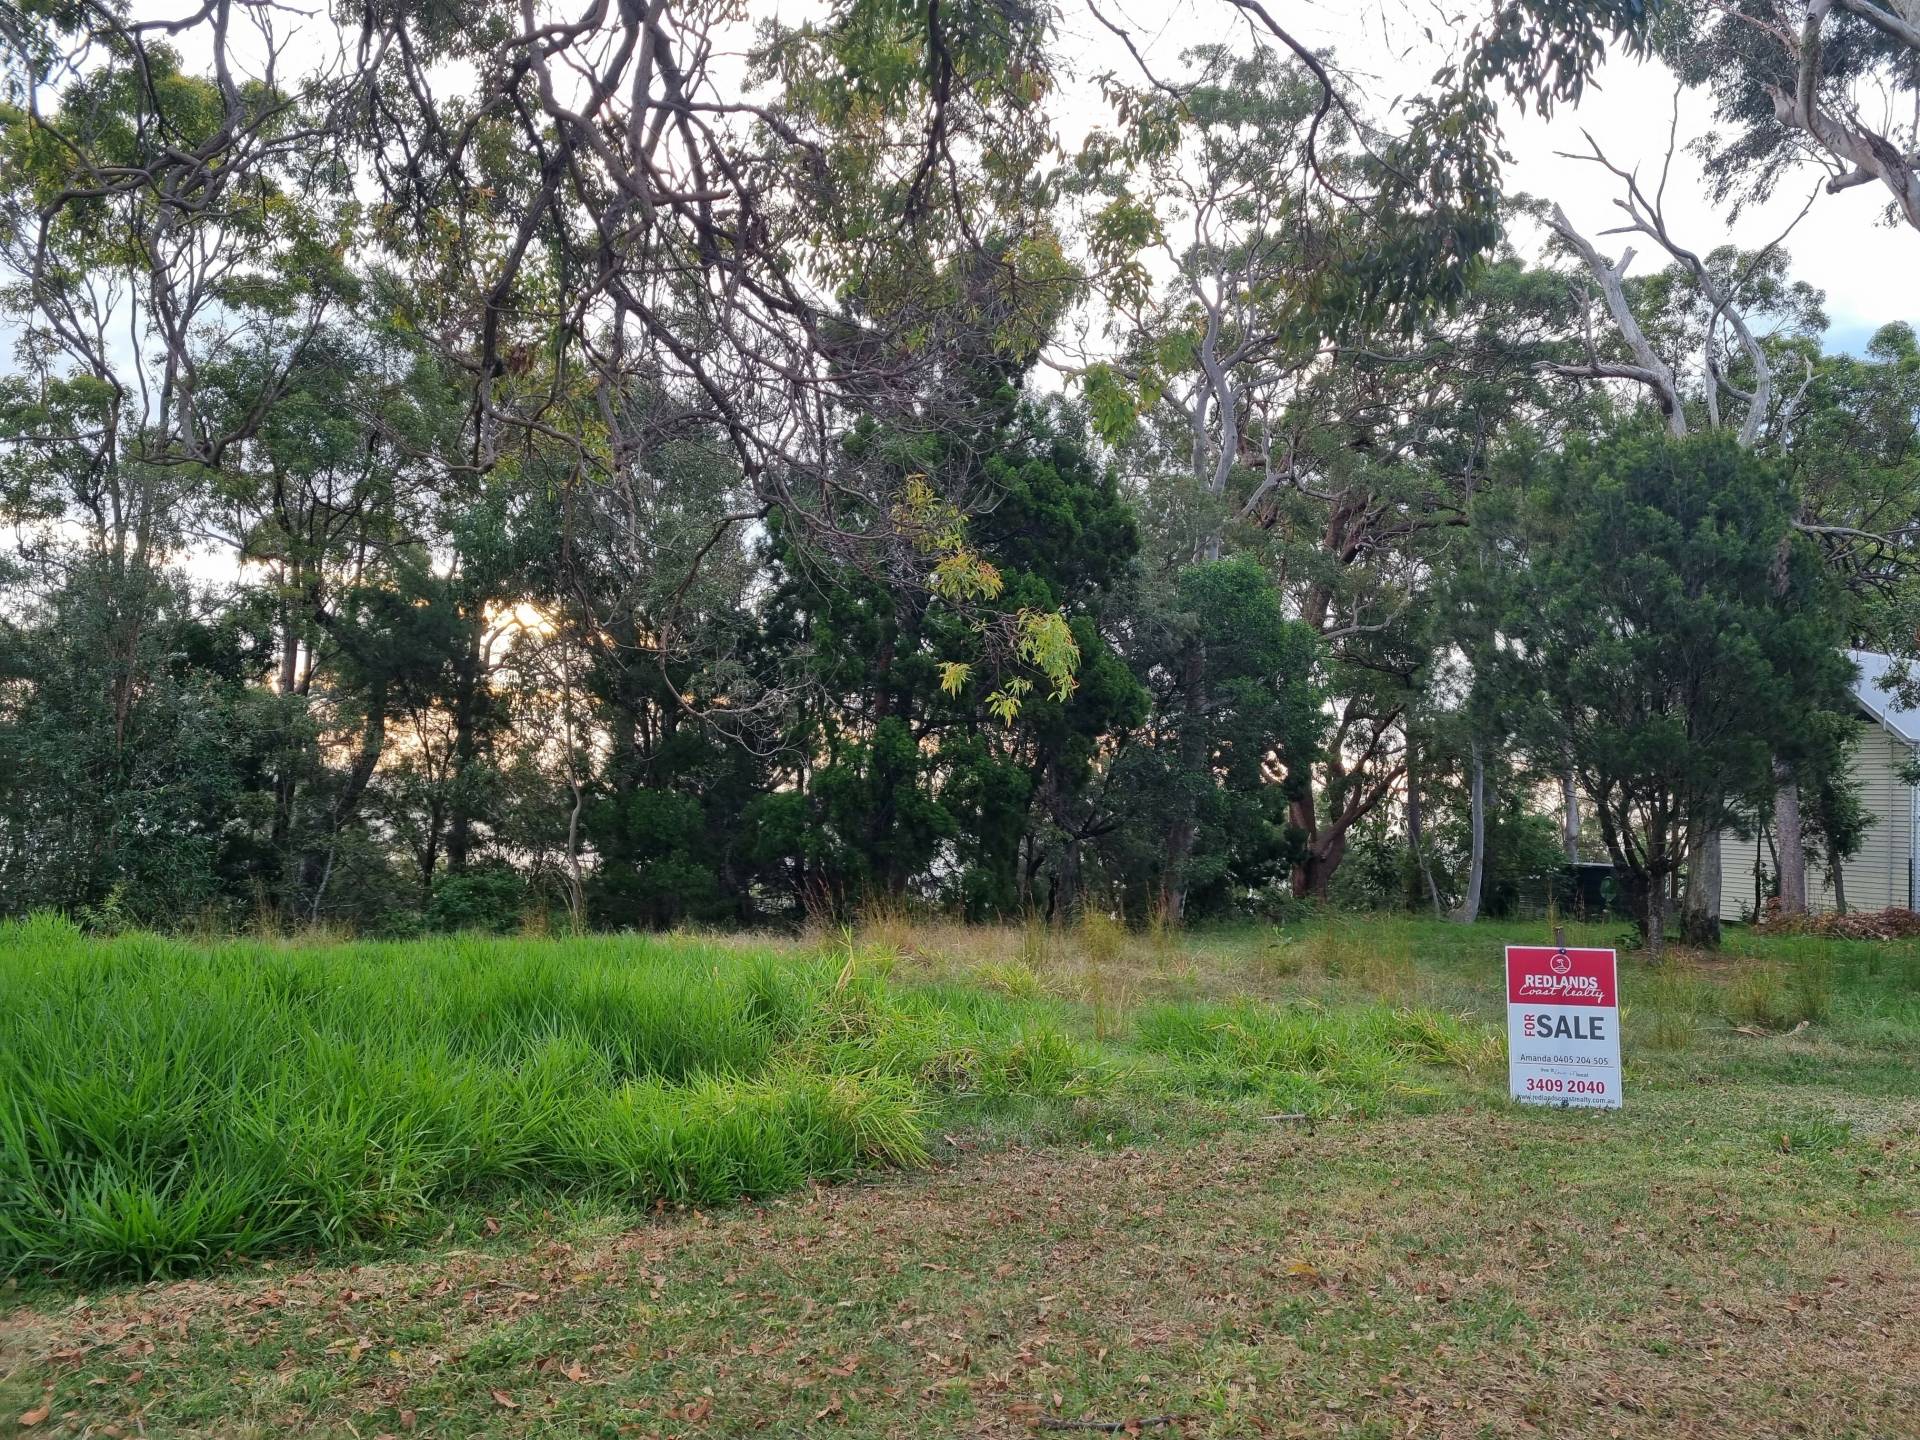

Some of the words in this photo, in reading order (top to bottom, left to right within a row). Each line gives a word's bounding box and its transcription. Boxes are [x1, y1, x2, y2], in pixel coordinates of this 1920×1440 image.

[1525, 974, 1598, 989] REDLANDS
[1519, 984, 1557, 996] Coast
[1562, 985, 1605, 1004] Realty
[1524, 1014, 1535, 1037] FOR
[1537, 1014, 1605, 1040] SALE
[1520, 1054, 1551, 1062] Amanda
[1553, 1055, 1574, 1063] 0405
[1576, 1056, 1591, 1064] 204
[1594, 1057, 1608, 1065] 505
[1526, 1078, 1563, 1092] 3409
[1567, 1080, 1605, 1094] 2040
